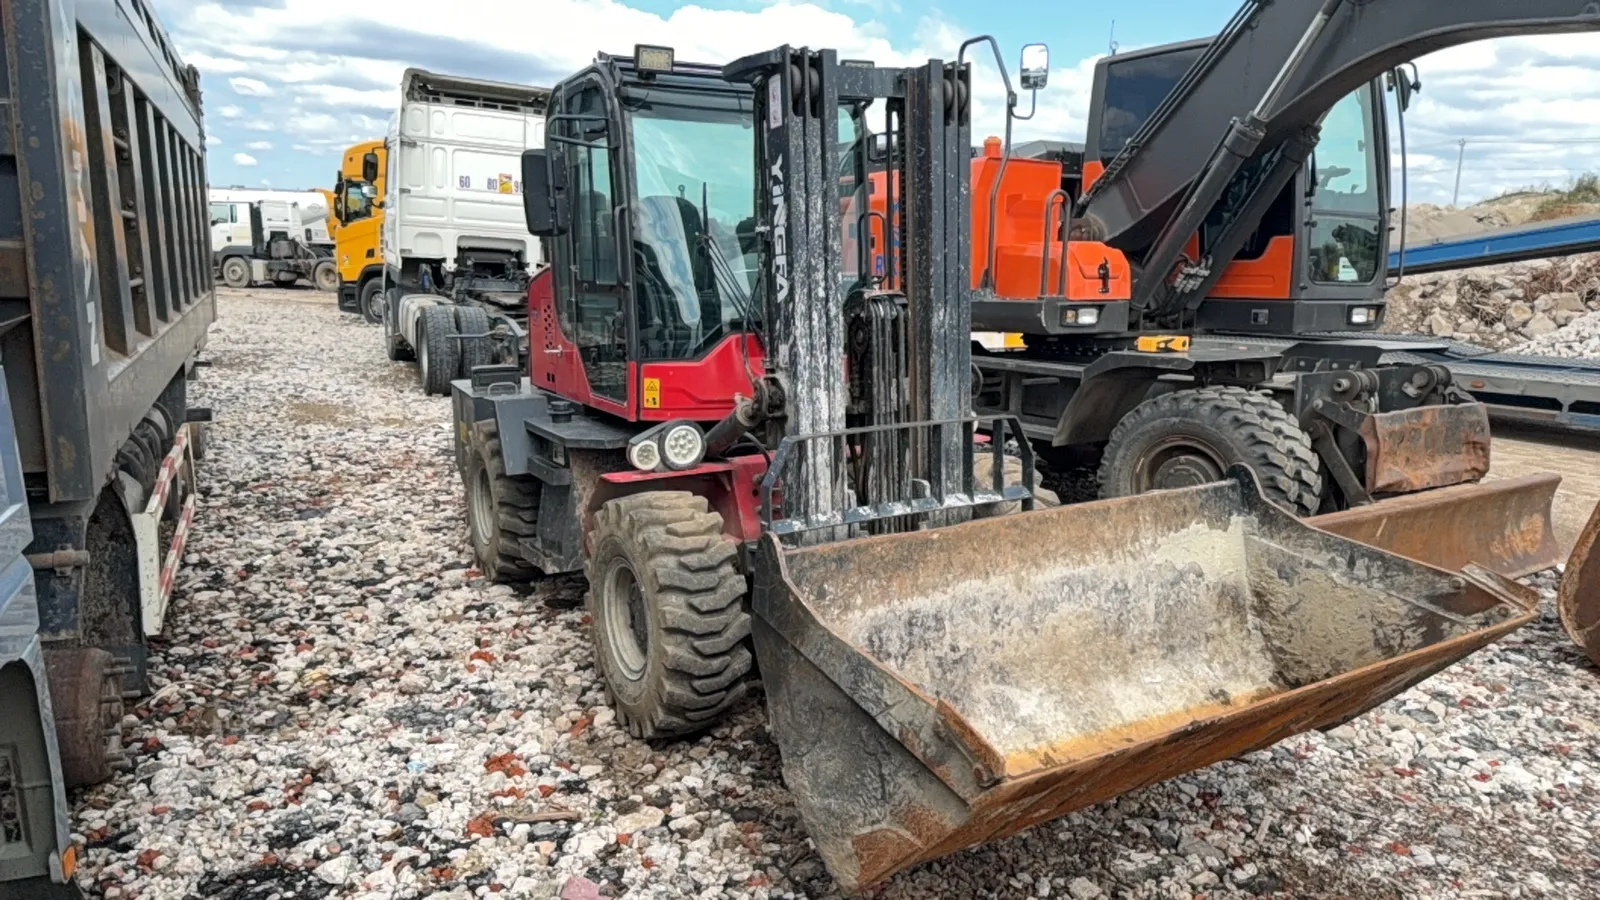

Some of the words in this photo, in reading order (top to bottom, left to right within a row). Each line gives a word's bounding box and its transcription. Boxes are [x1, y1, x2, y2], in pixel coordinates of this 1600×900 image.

[459, 175, 471, 188] 60
[487, 177, 498, 190] 80
[771, 153, 789, 303] YINGFA
